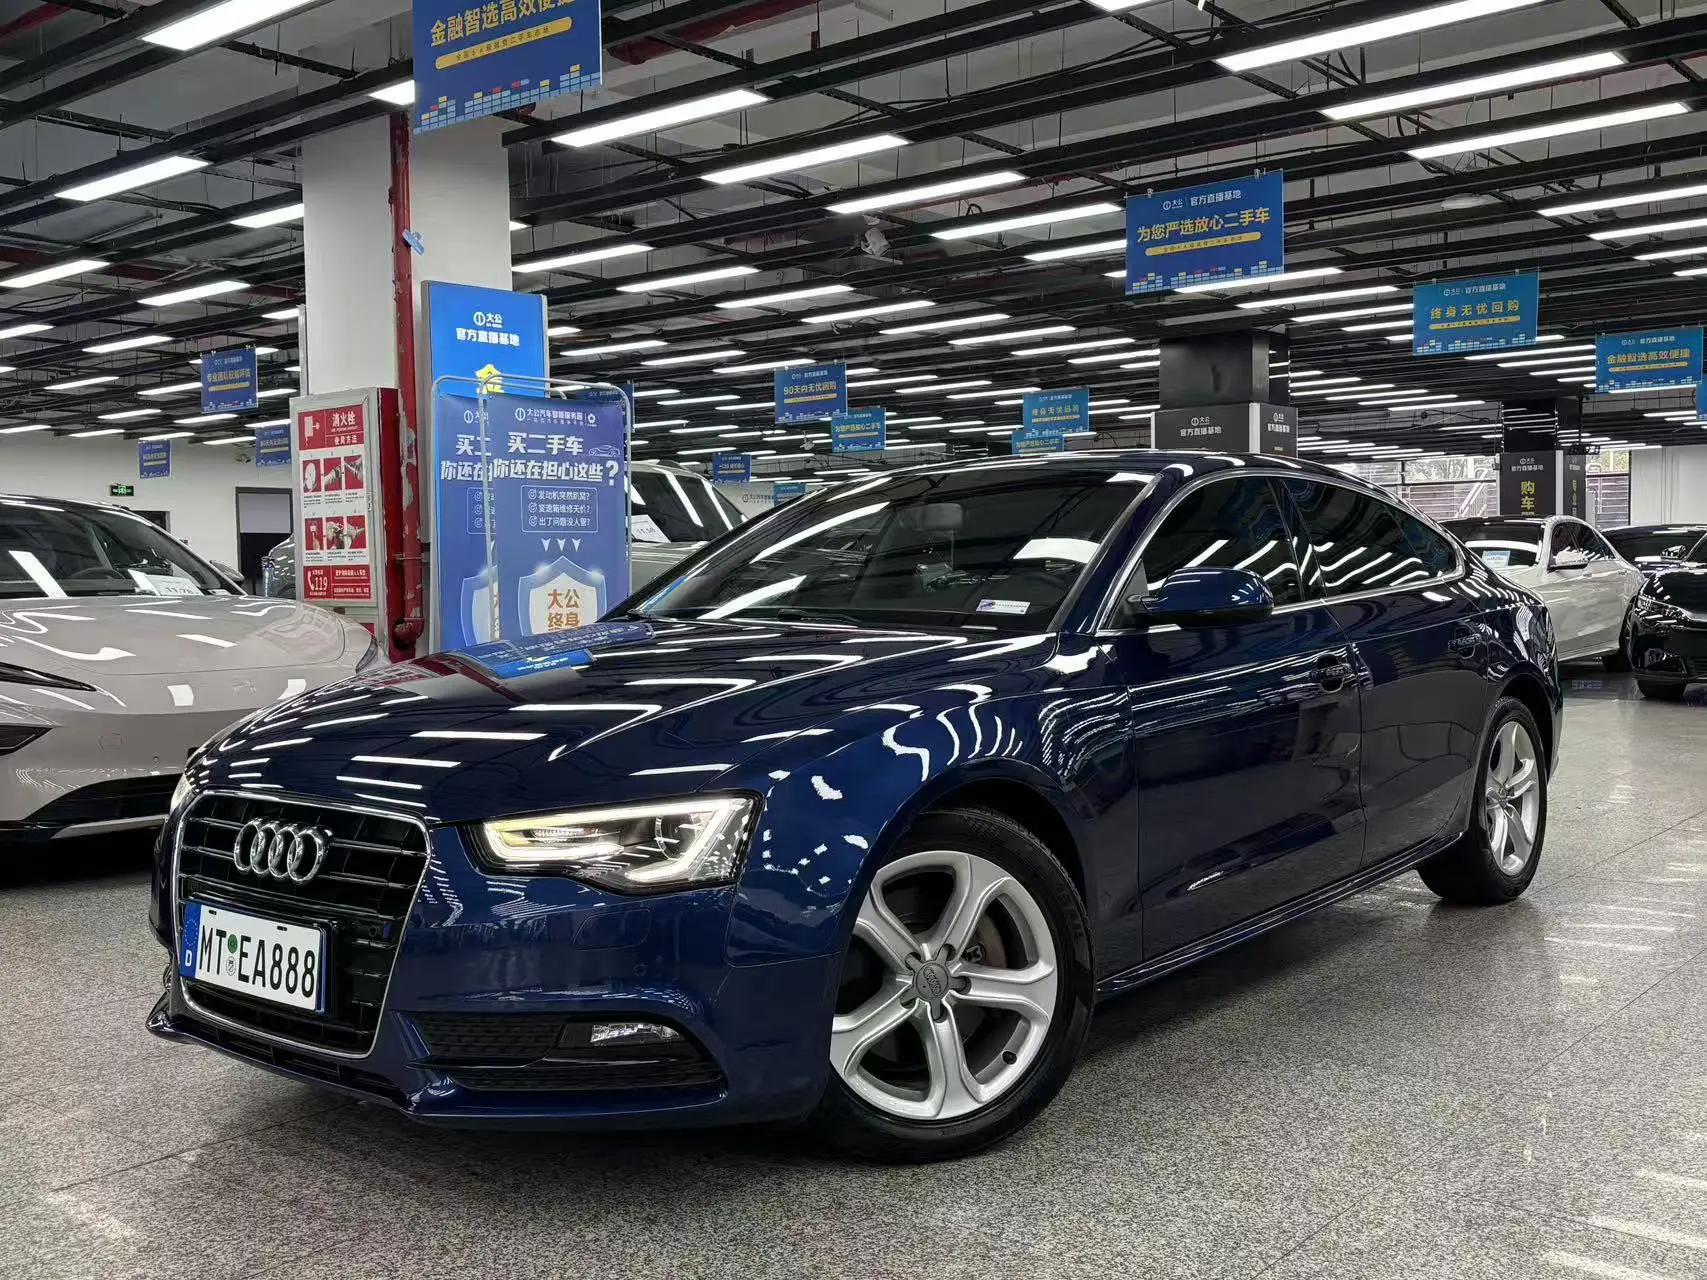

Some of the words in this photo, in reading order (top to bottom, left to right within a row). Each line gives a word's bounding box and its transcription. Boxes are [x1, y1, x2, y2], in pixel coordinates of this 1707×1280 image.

[430, 0, 577, 48] 金融智选高效便
[1190, 189, 1242, 207] 官方直播基地
[1137, 207, 1271, 243] 为您严选放心二手车
[486, 312, 502, 323] 大公
[455, 328, 520, 347] 官方直播基地
[332, 411, 356, 427] 消火栓
[507, 431, 583, 456] 买二手车
[493, 458, 619, 486] 你还在担心这些?
[538, 503, 591, 514] 变速箱维修天价?
[539, 516, 591, 527] 出了问题没人管?
[314, 576, 328, 591] 119
[548, 588, 580, 610] 大公
[548, 611, 579, 628] 终身
[185, 949, 193, 967] D
[199, 924, 227, 976] MT
[238, 934, 316, 998] EA888
